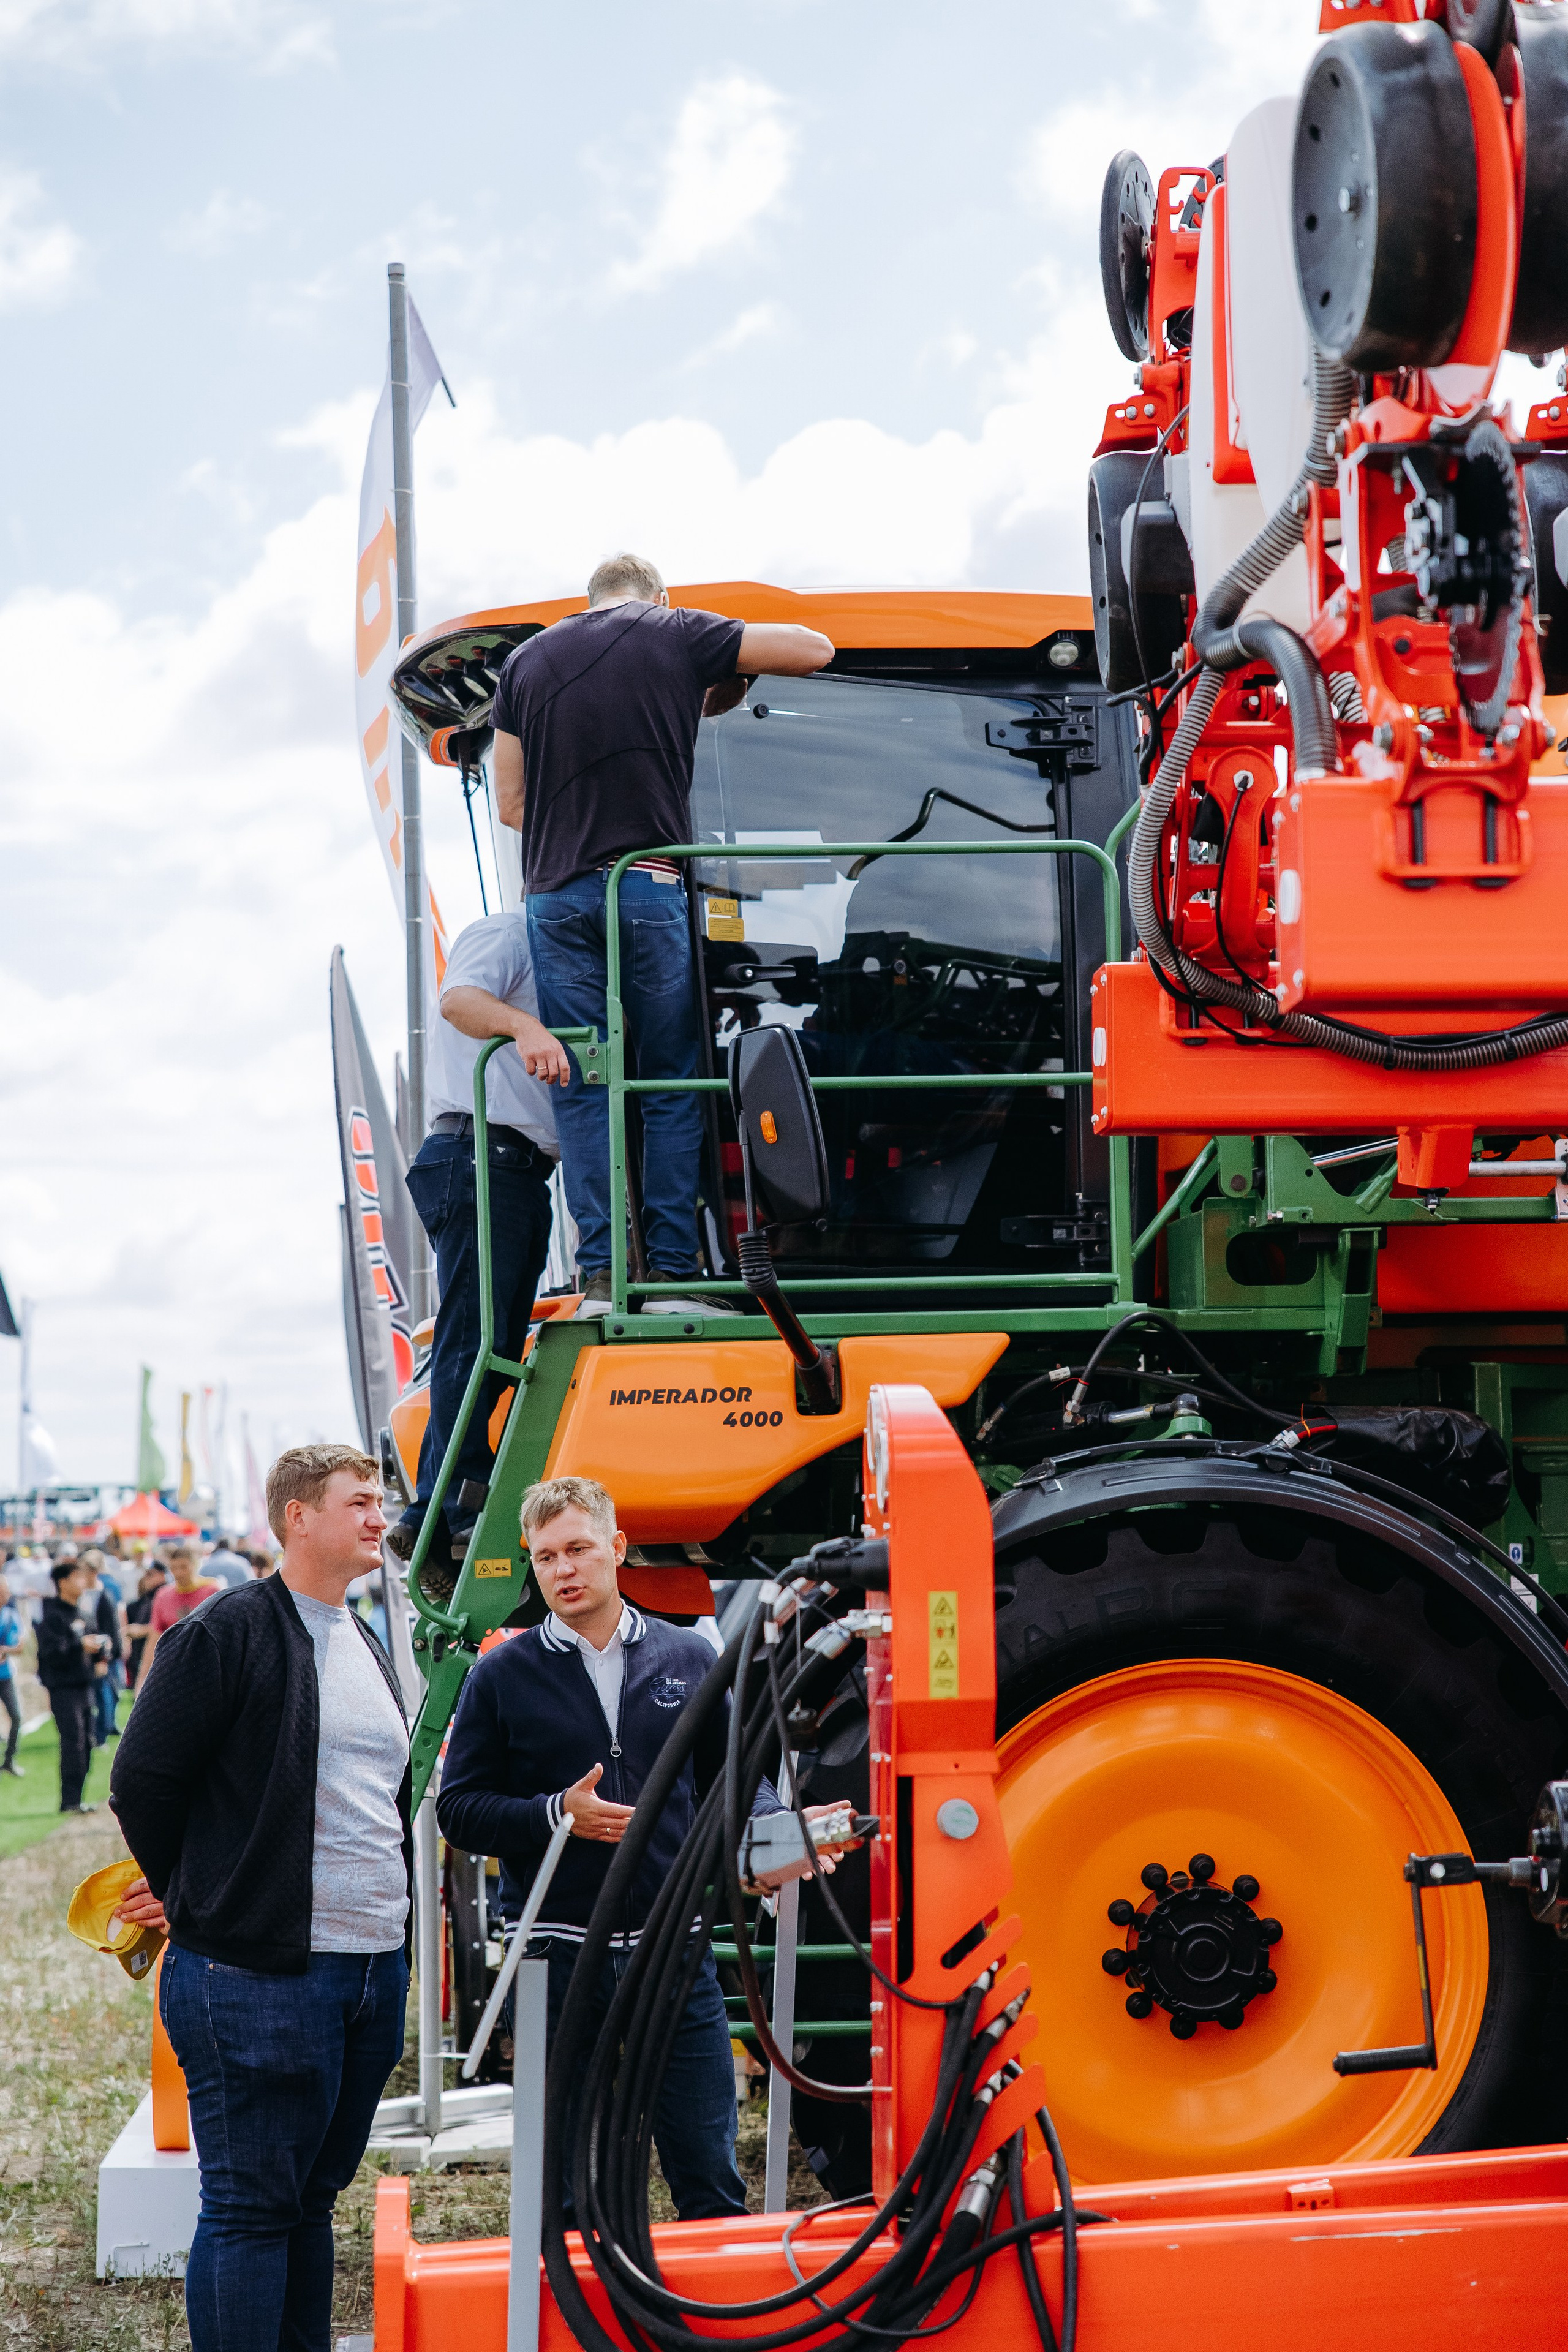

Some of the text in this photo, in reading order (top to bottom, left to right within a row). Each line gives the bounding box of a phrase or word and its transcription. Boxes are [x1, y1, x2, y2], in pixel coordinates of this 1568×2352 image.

[609, 1387, 752, 1406] IMPERADOR
[723, 1411, 783, 1427] 4000
[654, 1698, 681, 1708] CALIFORNIA
